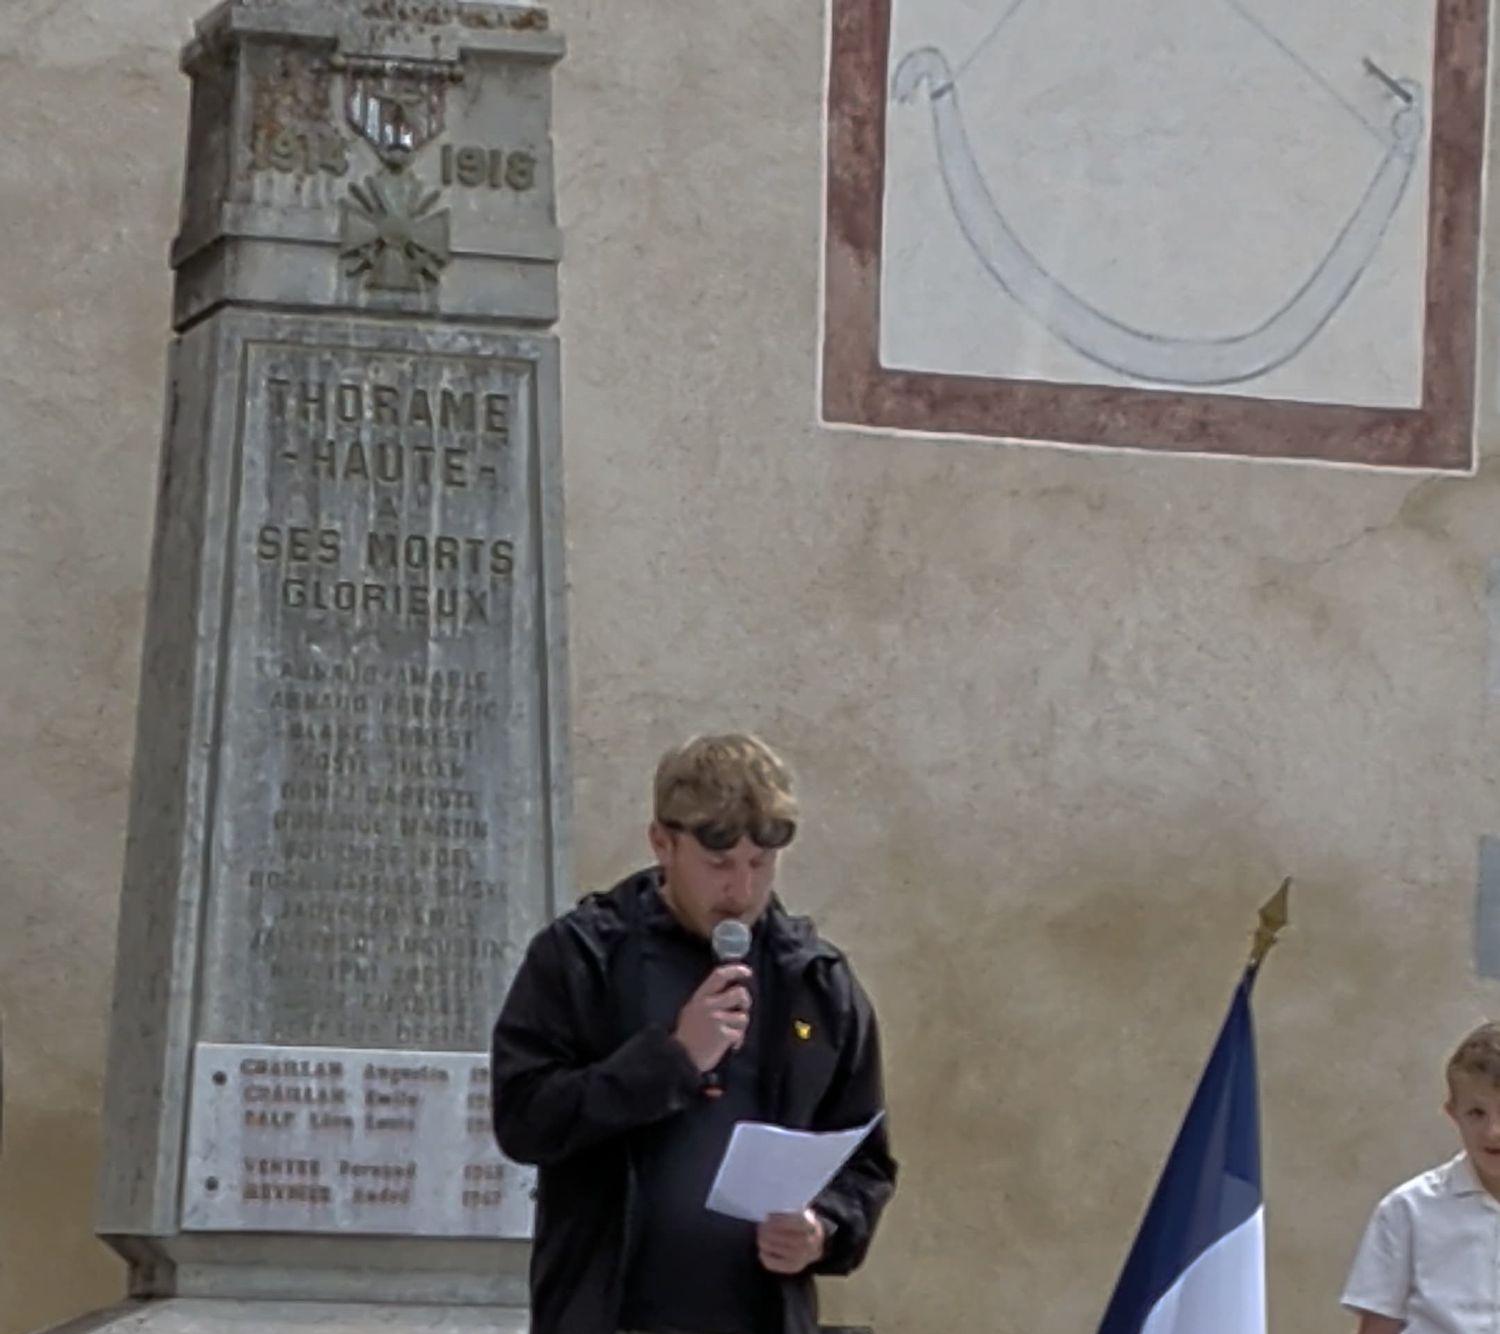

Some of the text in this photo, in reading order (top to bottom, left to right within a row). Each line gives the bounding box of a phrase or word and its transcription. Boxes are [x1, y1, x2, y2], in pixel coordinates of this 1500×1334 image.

[439, 143, 538, 192] 1918
[267, 377, 511, 433] THORAME
[257, 525, 515, 575] SES MORTS
[282, 577, 489, 626] GLORIEUX
